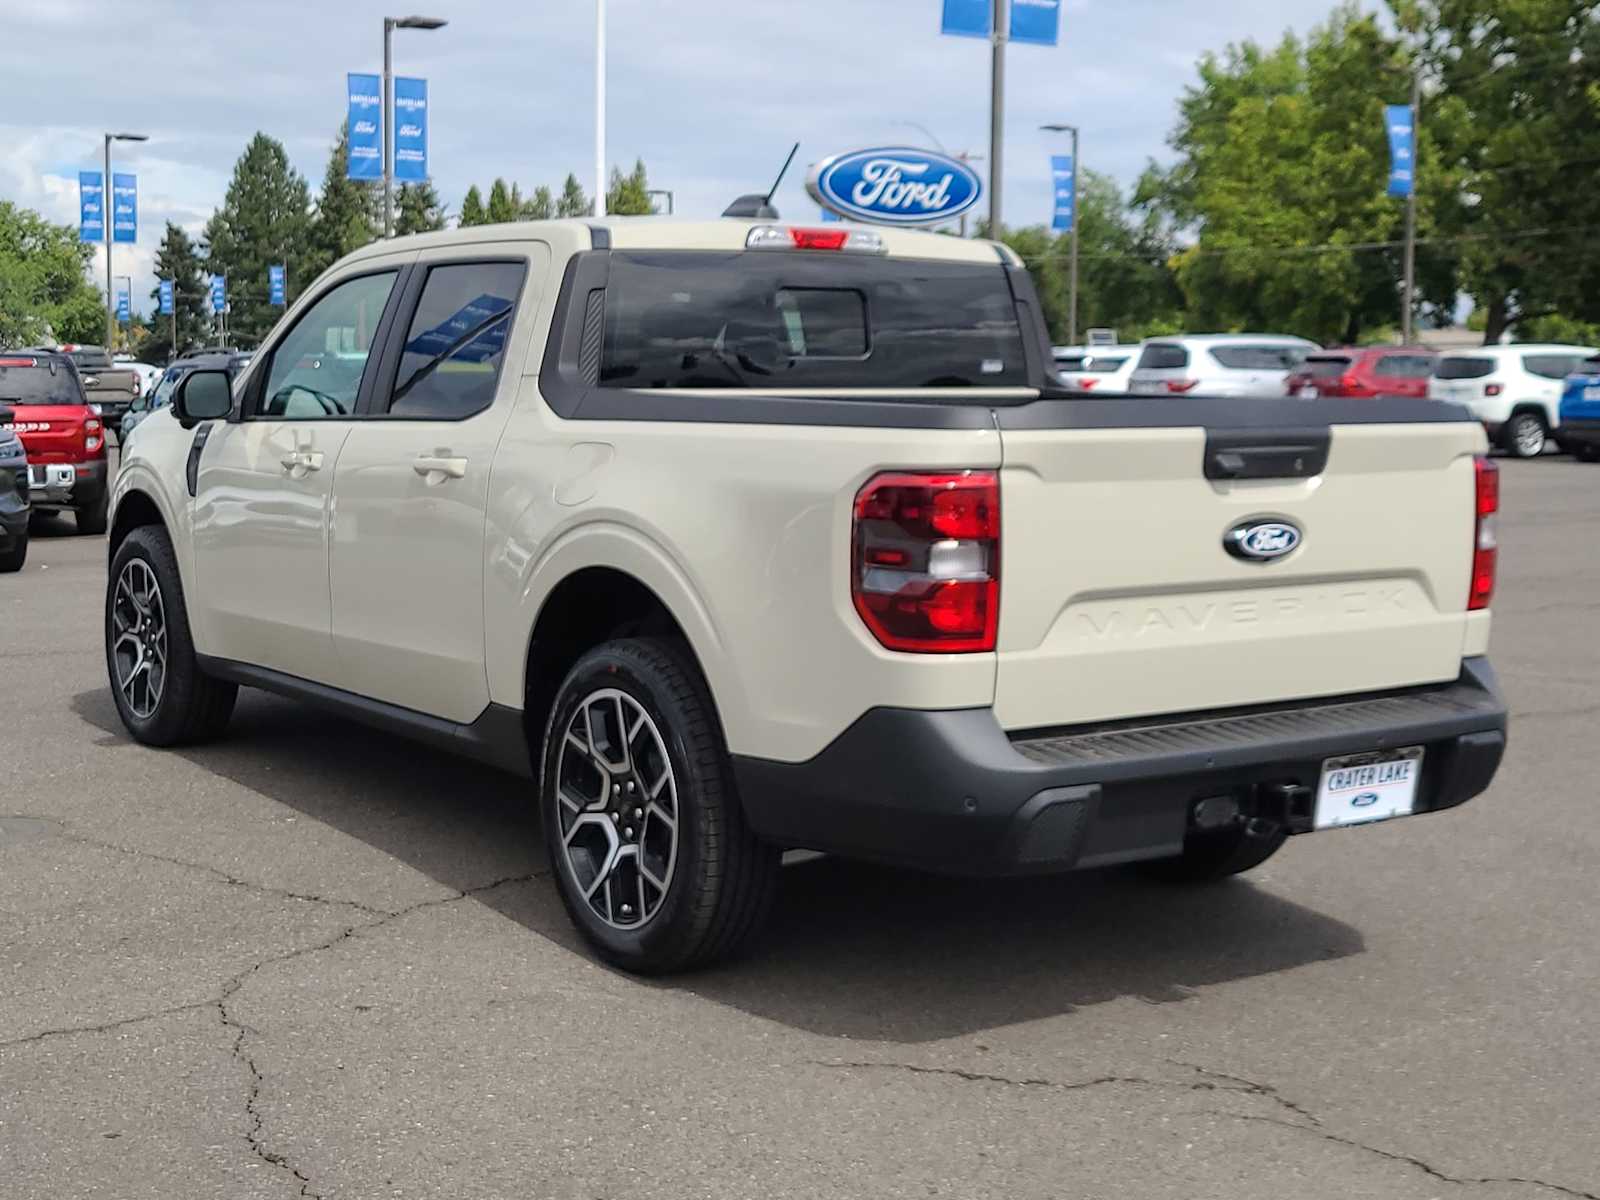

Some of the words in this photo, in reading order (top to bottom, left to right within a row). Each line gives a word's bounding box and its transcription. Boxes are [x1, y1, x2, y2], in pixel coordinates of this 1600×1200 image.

[852, 159, 953, 208] Ford
[1253, 527, 1290, 550] Ford
[1328, 766, 1376, 791] CRATER
[1378, 761, 1410, 782] LAKE
